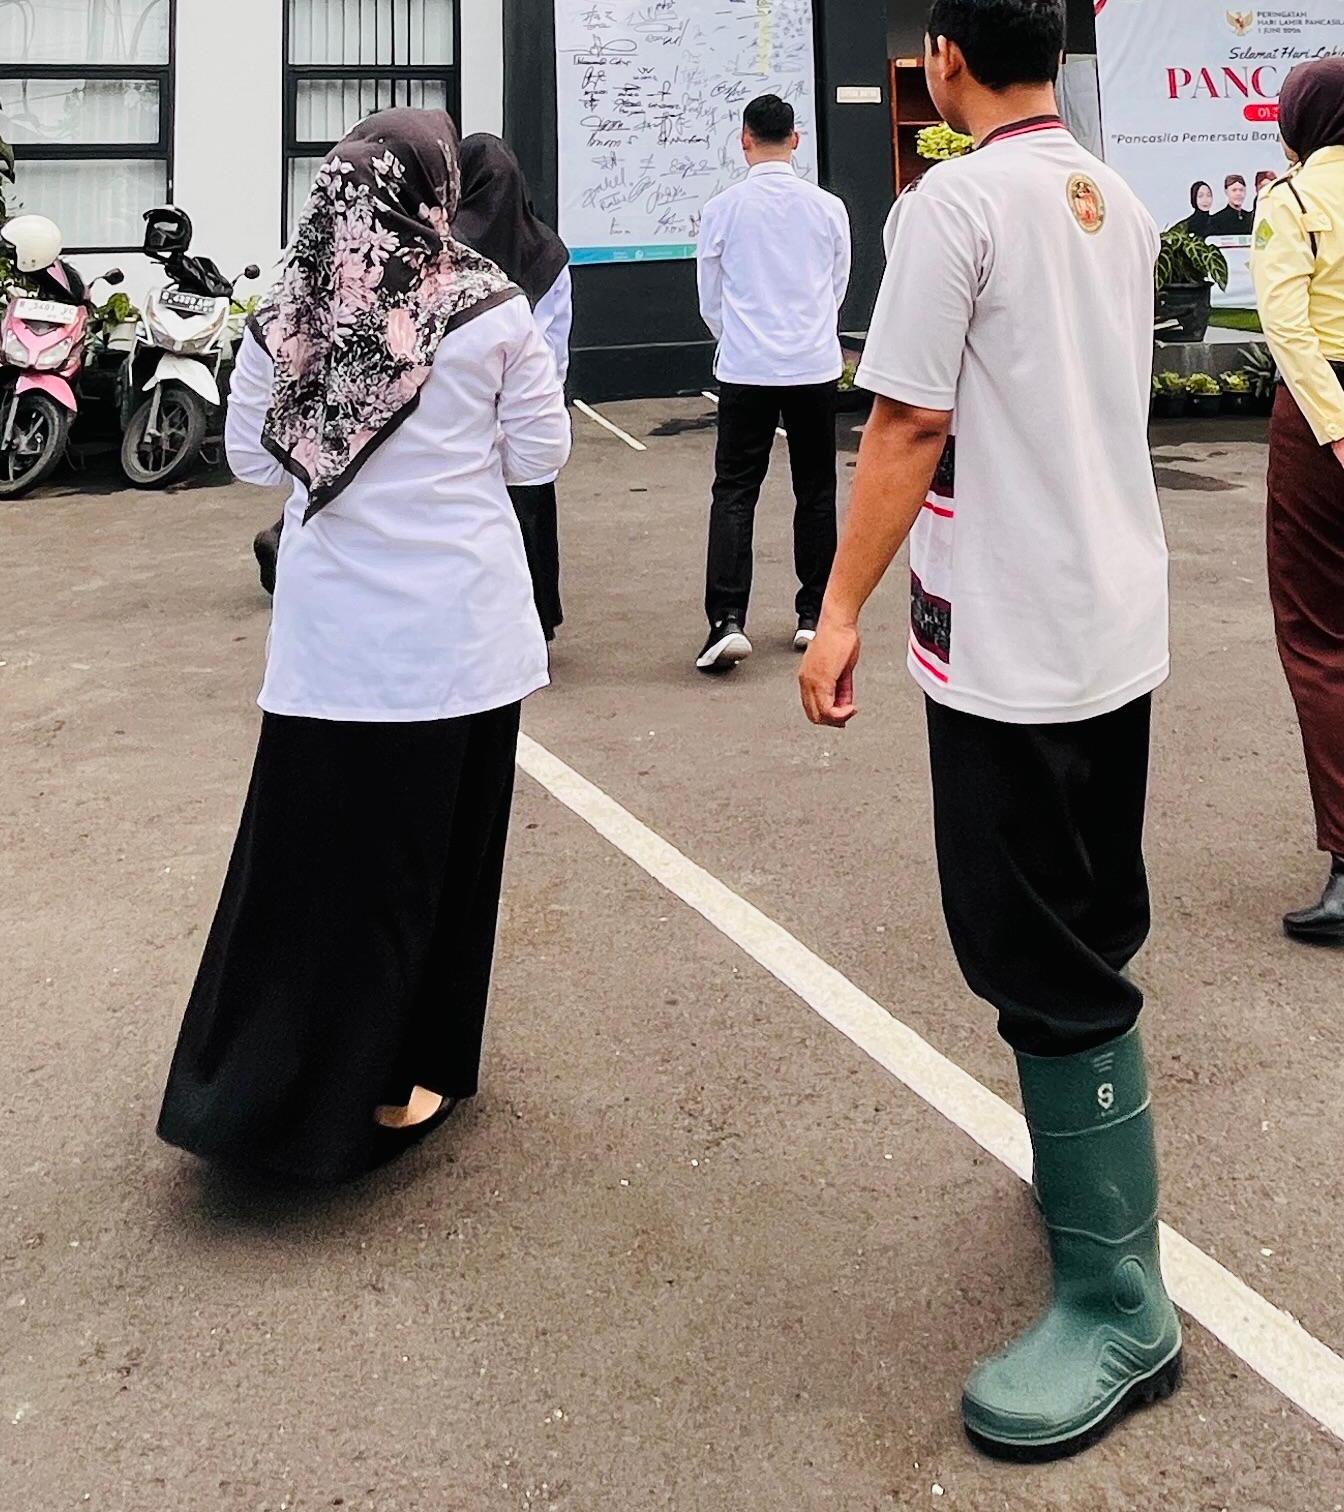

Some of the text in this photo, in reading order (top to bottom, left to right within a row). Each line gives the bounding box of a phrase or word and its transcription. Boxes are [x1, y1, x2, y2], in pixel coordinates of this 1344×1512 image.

[1228, 47, 1278, 60] Selamat
[1280, 47, 1310, 60] Hari
[1111, 133, 1179, 144] "Pancasila
[1182, 131, 1248, 143] Pemersatu
